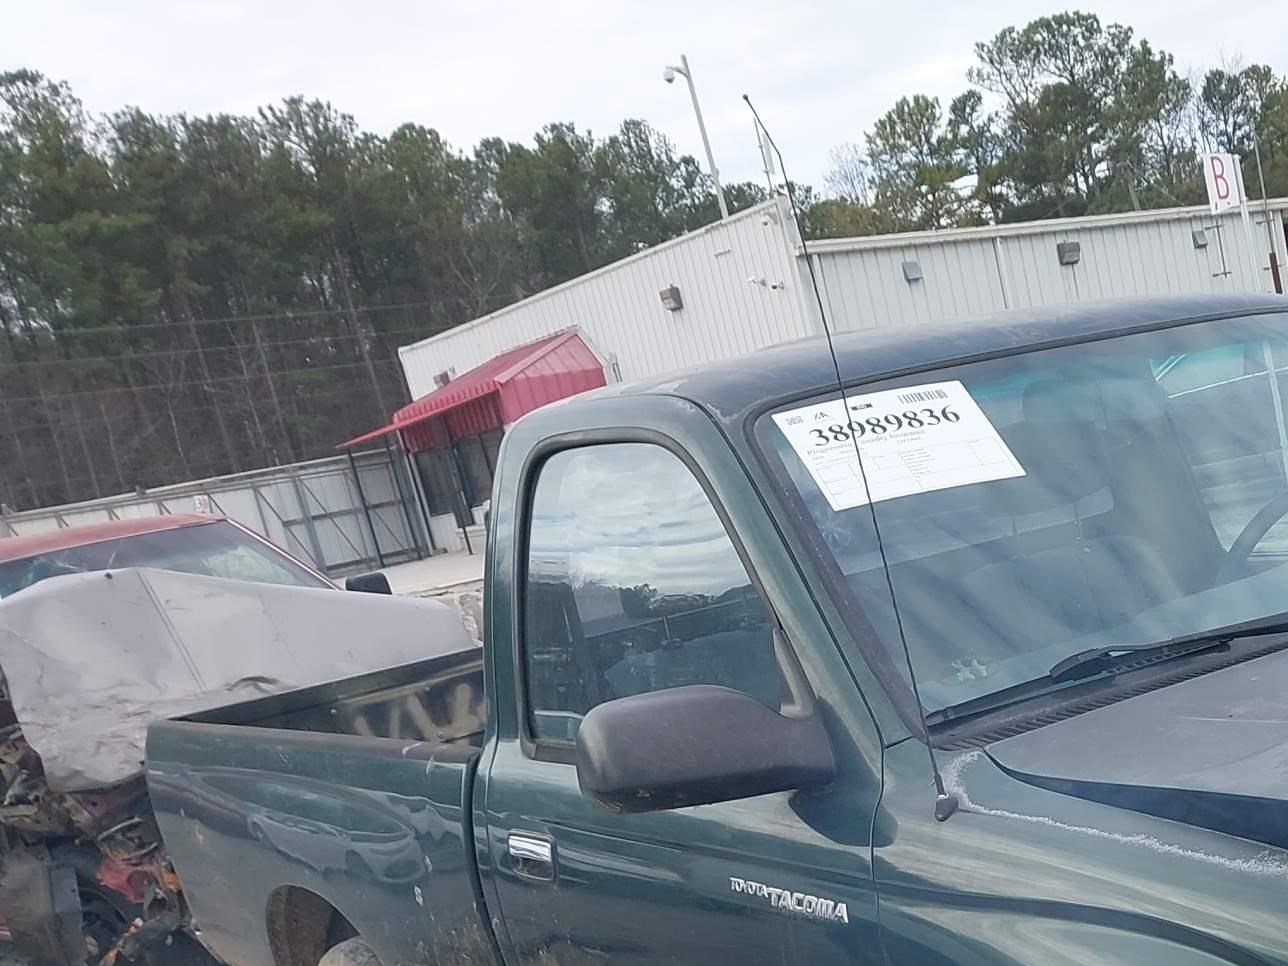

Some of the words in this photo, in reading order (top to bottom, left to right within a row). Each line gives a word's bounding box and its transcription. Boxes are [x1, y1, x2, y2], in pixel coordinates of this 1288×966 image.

[1210, 156, 1230, 200] B
[808, 404, 961, 447] 38989836
[729, 876, 769, 899] TOYOTA
[767, 886, 849, 924] TACOMA
